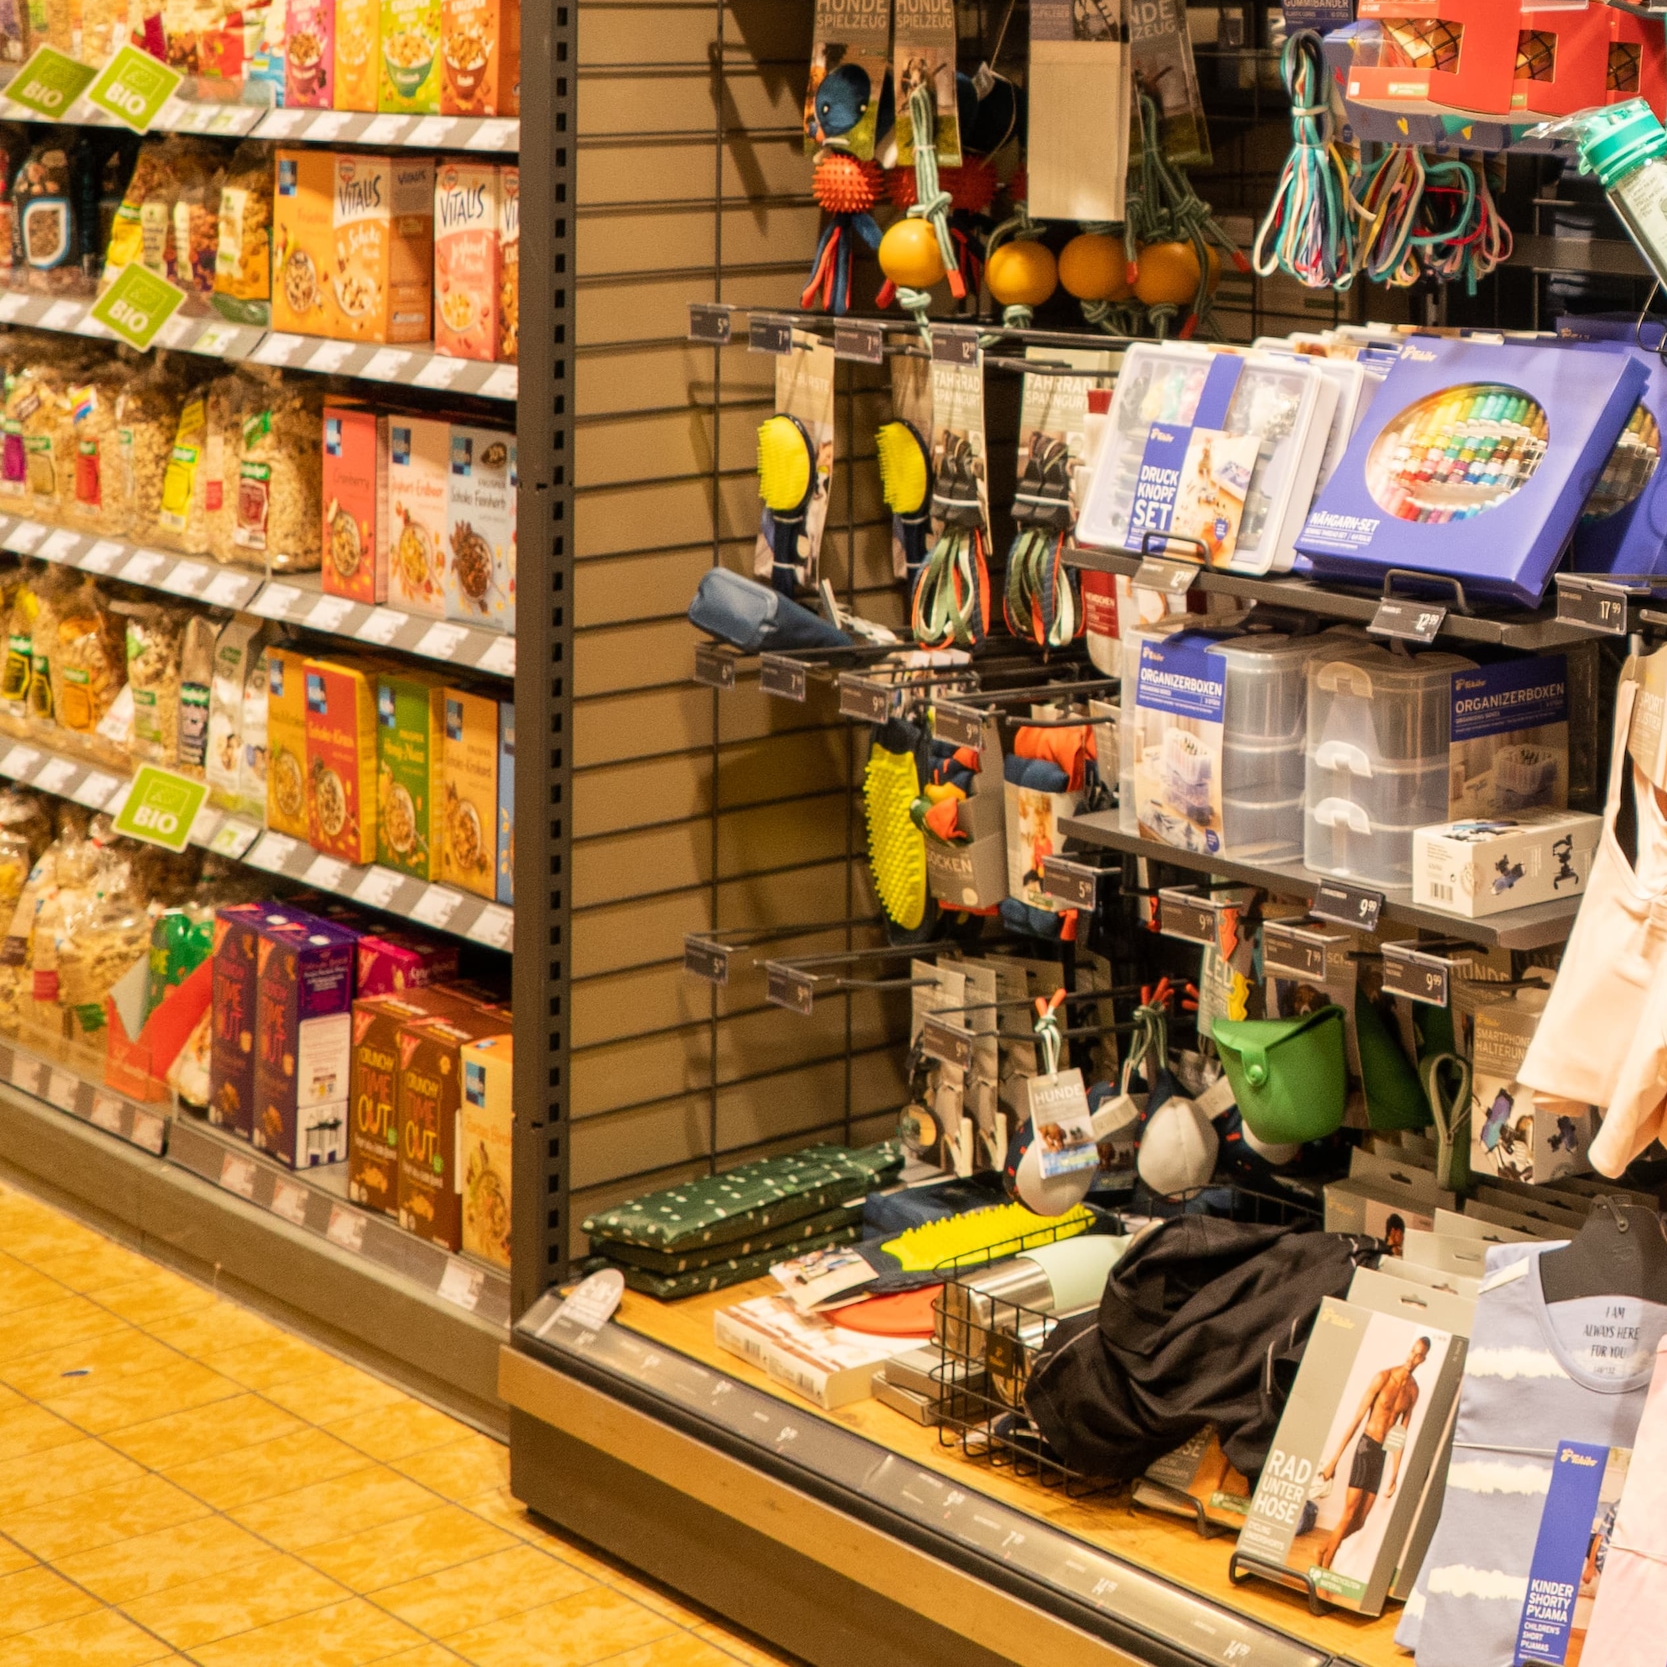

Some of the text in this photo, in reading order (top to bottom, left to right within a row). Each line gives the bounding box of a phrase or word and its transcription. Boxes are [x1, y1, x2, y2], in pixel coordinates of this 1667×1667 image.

[818, 12, 886, 30] SPIELZEUG
[896, 12, 952, 29] SPIELZEUG
[104, 85, 146, 113] BIO
[108, 300, 149, 332] BIO
[1142, 465, 1179, 486] DRUCK
[1138, 484, 1175, 503] KNOPF
[1133, 500, 1172, 529] SET
[1310, 511, 1380, 532] NÄHGARN-SET
[1141, 667, 1222, 697] ORGANIZERBOXEN
[1455, 682, 1564, 715] ORGANIZERBOXEN
[133, 805, 178, 835] BIO
[358, 1096, 391, 1132] OUT
[406, 1122, 438, 1162] OUT
[1584, 1324, 1640, 1340] ALWAYS HERE
[1591, 1345, 1626, 1359] FOR YOU
[1268, 1449, 1312, 1481] RAD
[1262, 1475, 1304, 1502] UNTER
[1254, 1494, 1299, 1524] HOSE
[1531, 1579, 1574, 1598] KINDER
[1529, 1592, 1571, 1610] SHORTY
[1527, 1605, 1568, 1623] PYJAMA
[1521, 1639, 1549, 1652] PYJAMAS
[1522, 1630, 1543, 1641] SHORT
